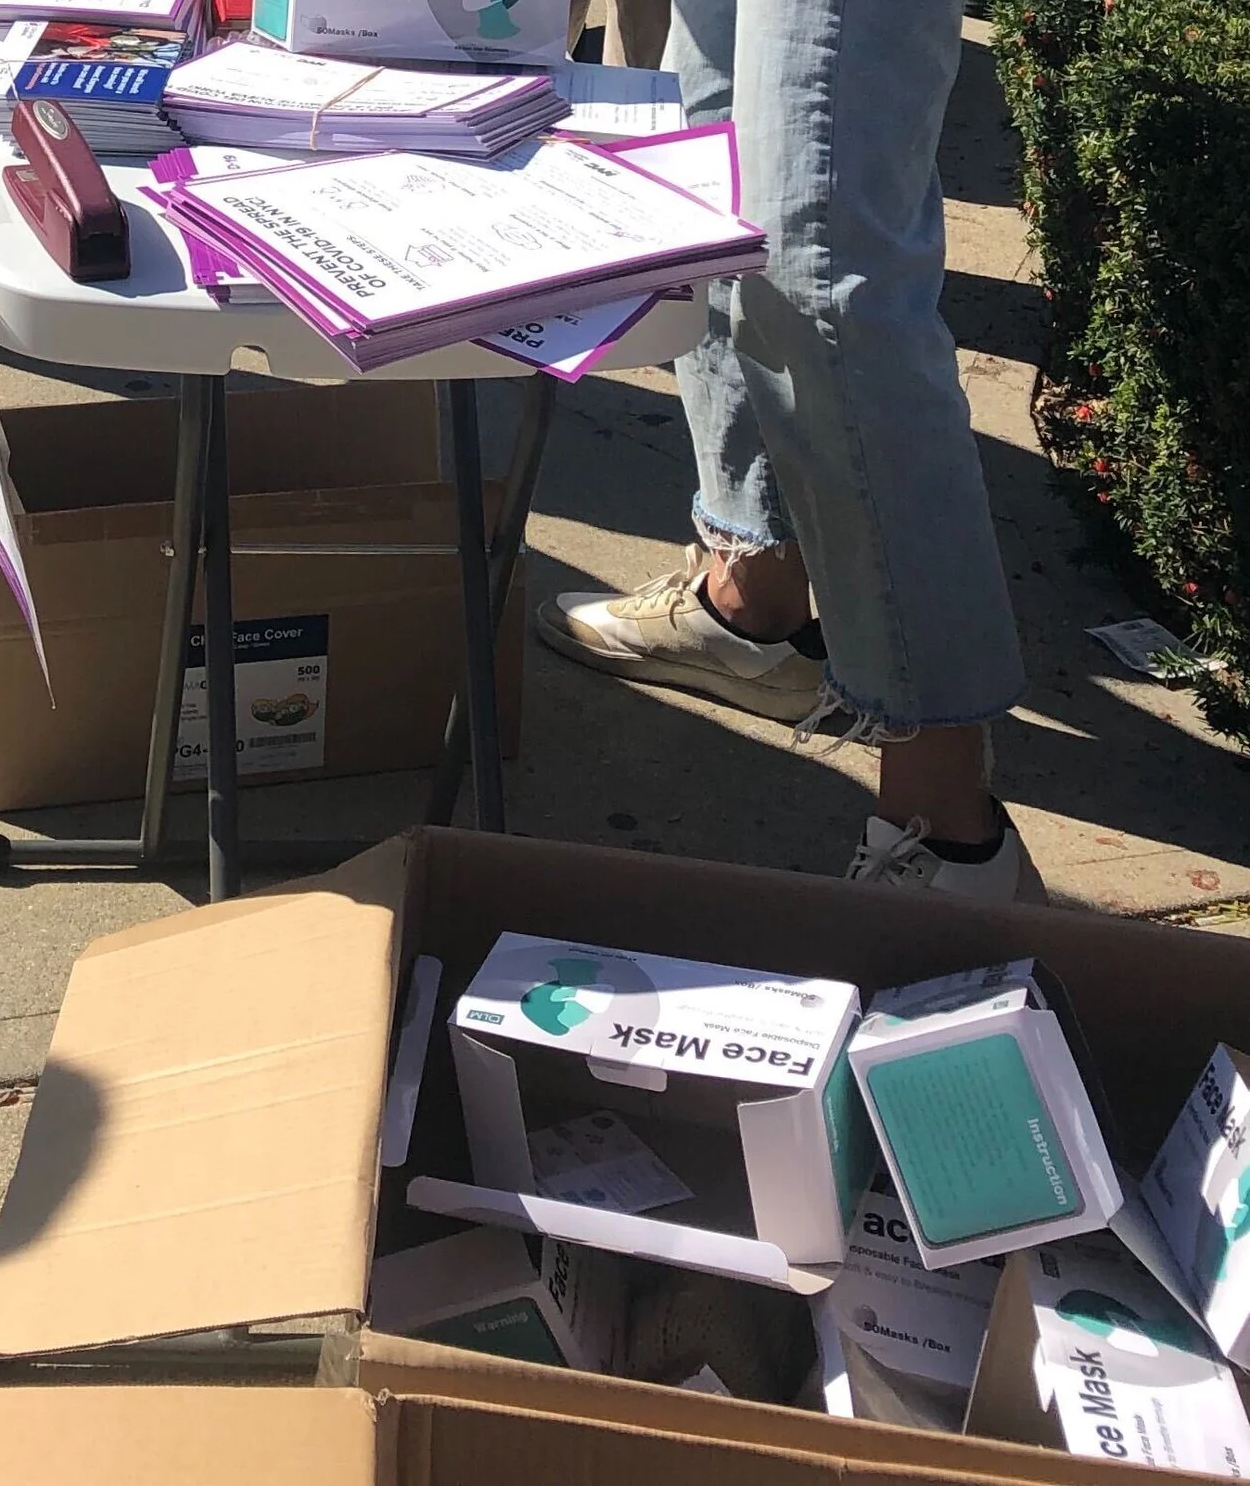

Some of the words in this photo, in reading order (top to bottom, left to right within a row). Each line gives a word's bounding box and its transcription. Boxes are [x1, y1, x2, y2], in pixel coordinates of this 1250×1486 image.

[223, 196, 280, 231] SPREAD
[244, 196, 283, 217] NYC!
[279, 214, 301, 229] IN
[273, 229, 307, 251] THE
[296, 226, 364, 272] COVID-19
[301, 249, 375, 299] PREVENT
[373, 253, 404, 275] THESE
[358, 271, 387, 289] OF
[401, 272, 427, 291] TAKE
[264, 627, 303, 641] Cover
[297, 665, 321, 676] 500
[609, 1022, 711, 1061] Mask
[722, 1042, 815, 1077] Face
[1026, 1118, 1068, 1206] Instruction
[862, 1212, 915, 1243] ac
[549, 1241, 571, 1313] Face
[472, 1310, 529, 1334] Warning
[1069, 1346, 1119, 1420] Mask
[1096, 1424, 1129, 1459] ce
